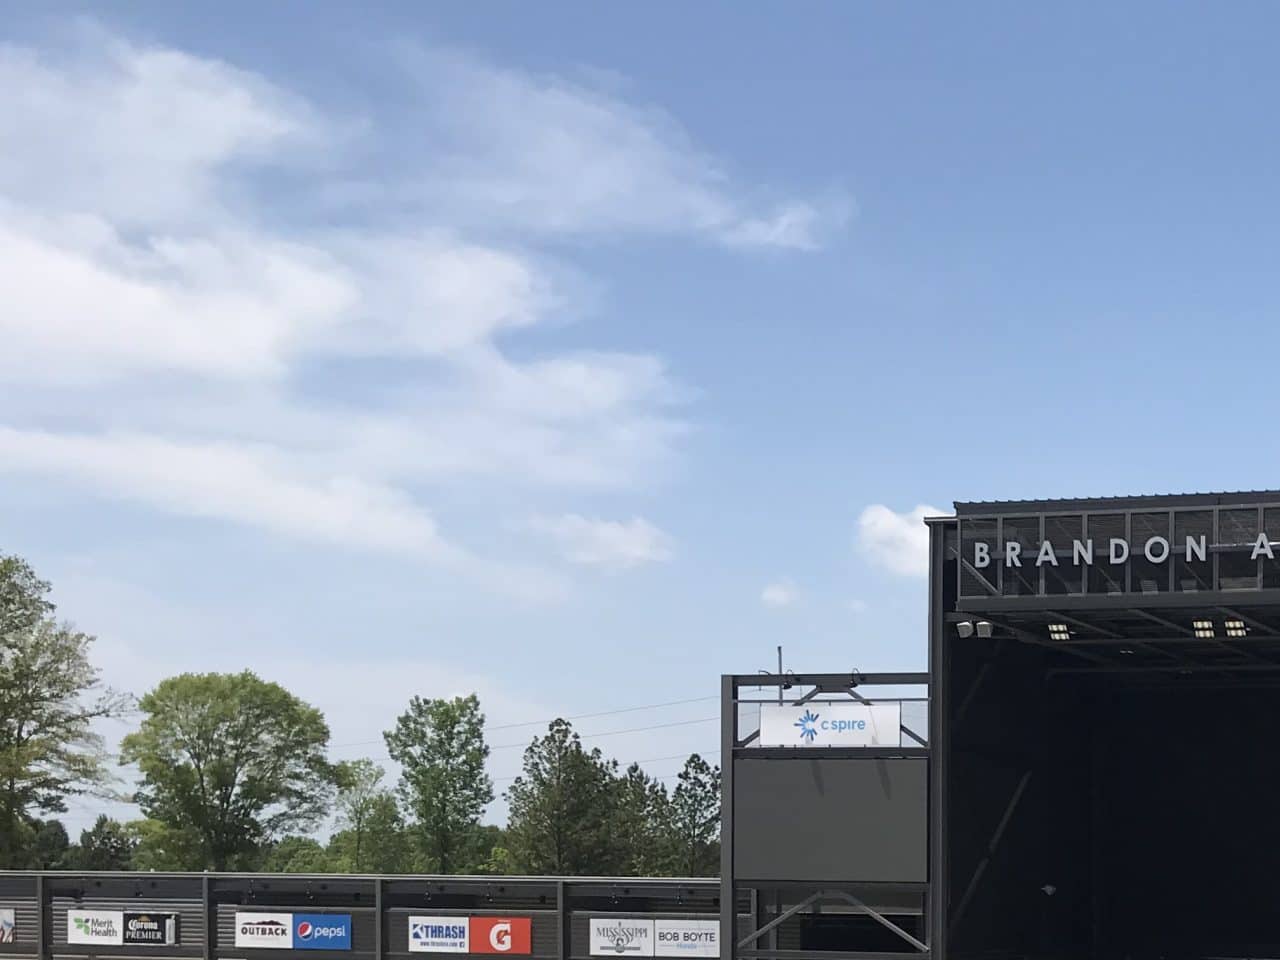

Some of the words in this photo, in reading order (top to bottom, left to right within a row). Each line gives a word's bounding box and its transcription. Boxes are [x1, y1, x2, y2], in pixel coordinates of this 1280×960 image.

[974, 534, 1208, 569] BRANDON
[831, 719, 866, 733] spire
[91, 917, 113, 927] Merit
[128, 919, 158, 930] Corona
[90, 927, 118, 938] Health
[126, 931, 162, 940] PREMIER
[241, 926, 288, 937] OUTBACK
[314, 925, 346, 939] pepsi
[423, 925, 466, 939] THRASH
[658, 931, 680, 942] BOB
[683, 931, 716, 942] BOYTE
[489, 923, 512, 952] G
